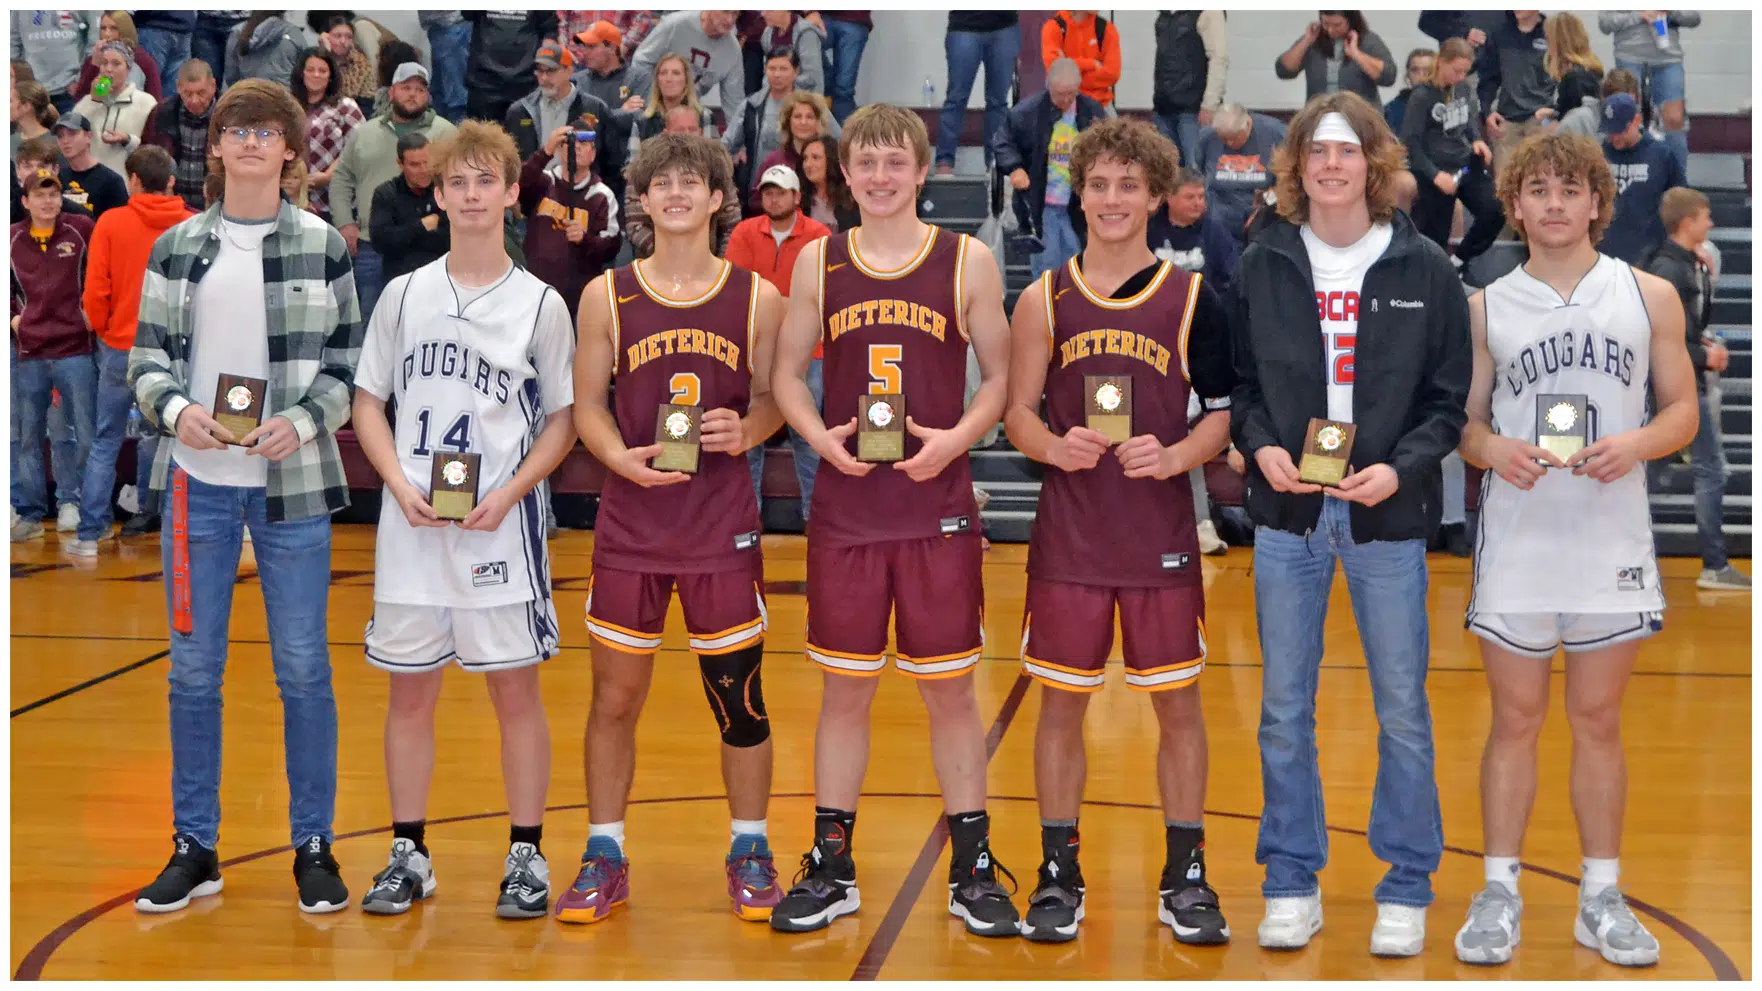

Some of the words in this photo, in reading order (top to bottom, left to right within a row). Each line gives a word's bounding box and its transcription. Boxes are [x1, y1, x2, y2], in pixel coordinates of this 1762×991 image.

[828, 299, 947, 342] DIETERICH
[627, 328, 740, 373] DIETERICH
[868, 344, 903, 395] 5
[1322, 332, 1357, 385] 2
[1506, 330, 1635, 398] COUGARS
[669, 372, 701, 406] 2
[409, 405, 475, 460] 14
